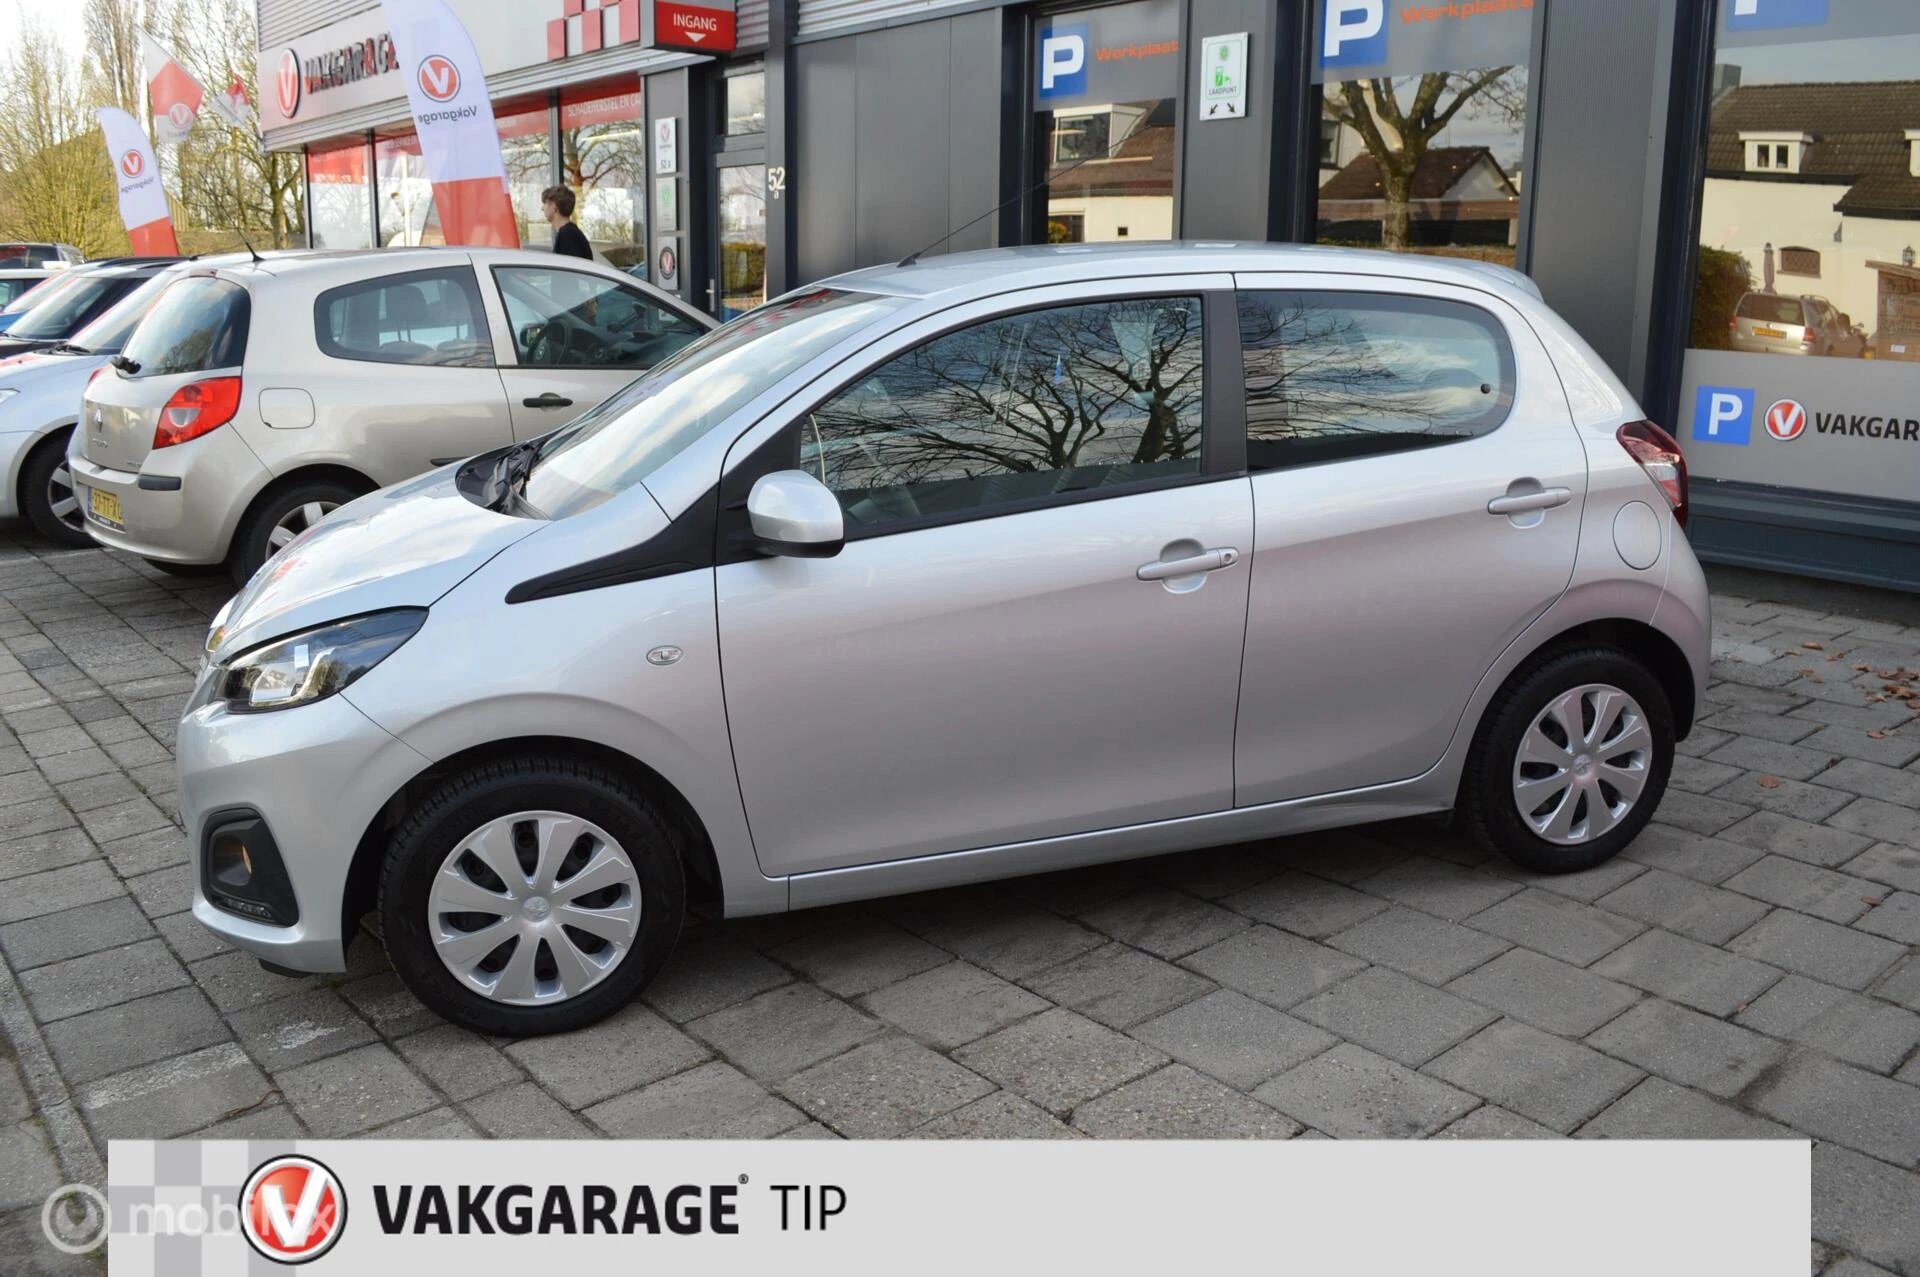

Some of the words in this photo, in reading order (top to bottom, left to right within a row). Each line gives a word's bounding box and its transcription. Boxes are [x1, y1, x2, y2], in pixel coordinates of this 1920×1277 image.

[673, 13, 717, 31] INGANG
[1324, 0, 1384, 57] P
[1042, 35, 1084, 89] P
[768, 167, 785, 191] 52
[1708, 392, 1742, 435] P
[1815, 412, 1920, 441] VAKGAR
